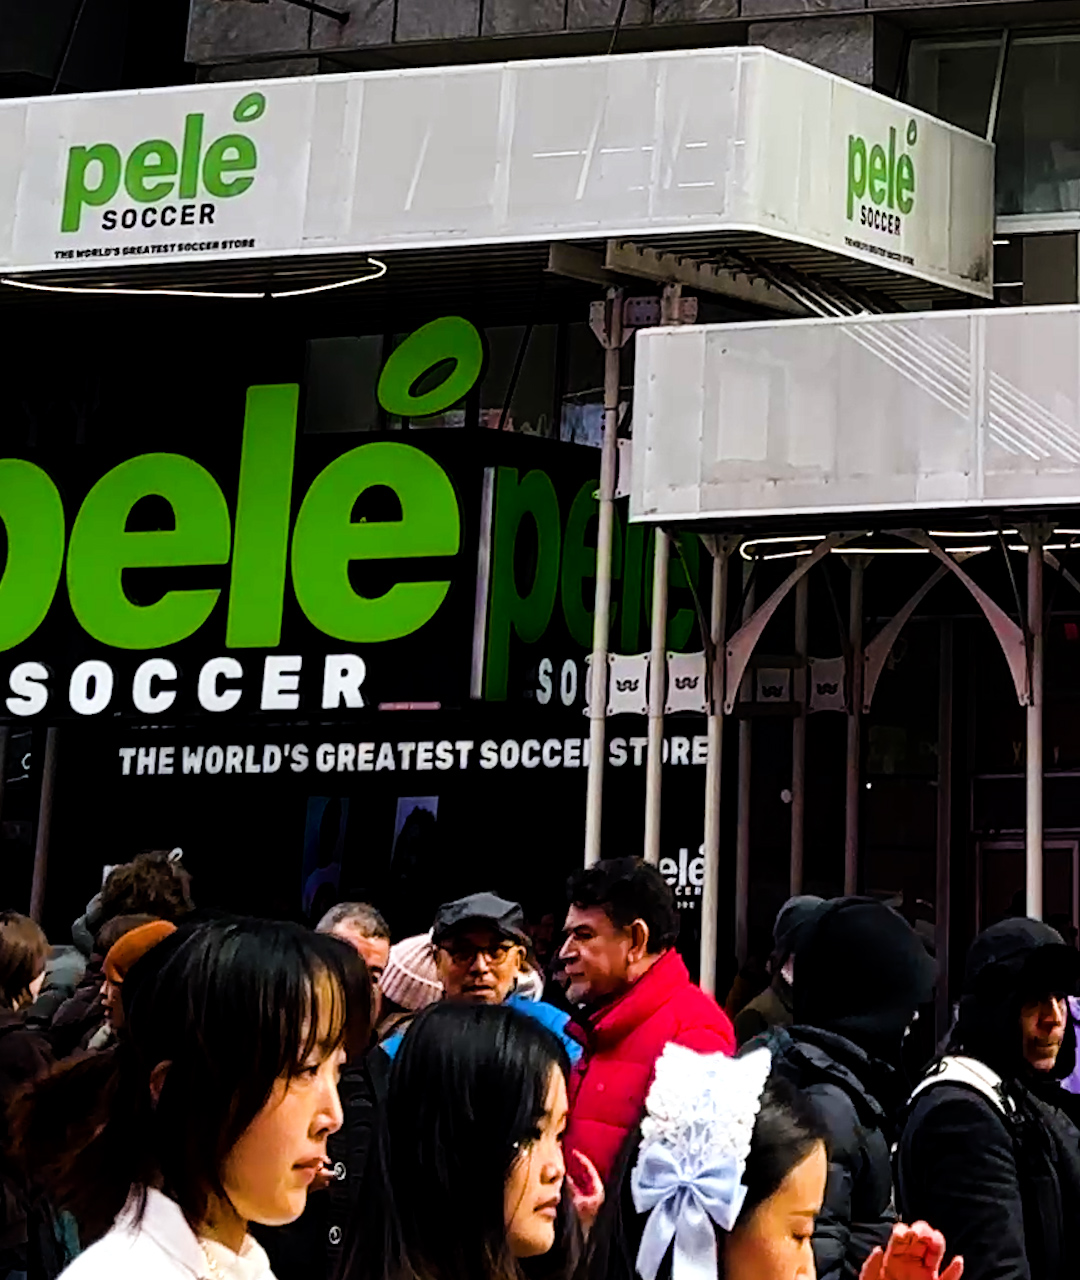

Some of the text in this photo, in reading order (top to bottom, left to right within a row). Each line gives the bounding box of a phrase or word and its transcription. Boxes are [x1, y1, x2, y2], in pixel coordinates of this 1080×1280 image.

[101, 203, 215, 230] SOCCER
[860, 205, 901, 236] SOCCER
[54, 239, 255, 259] THE WORLD'S GREATEST SOCCER STORE
[5, 653, 366, 716] SOCCER
[119, 746, 175, 776] THE
[182, 743, 310, 775] WORLD'S
[316, 740, 473, 773] GREATEST
[609, 736, 708, 767] STRE
